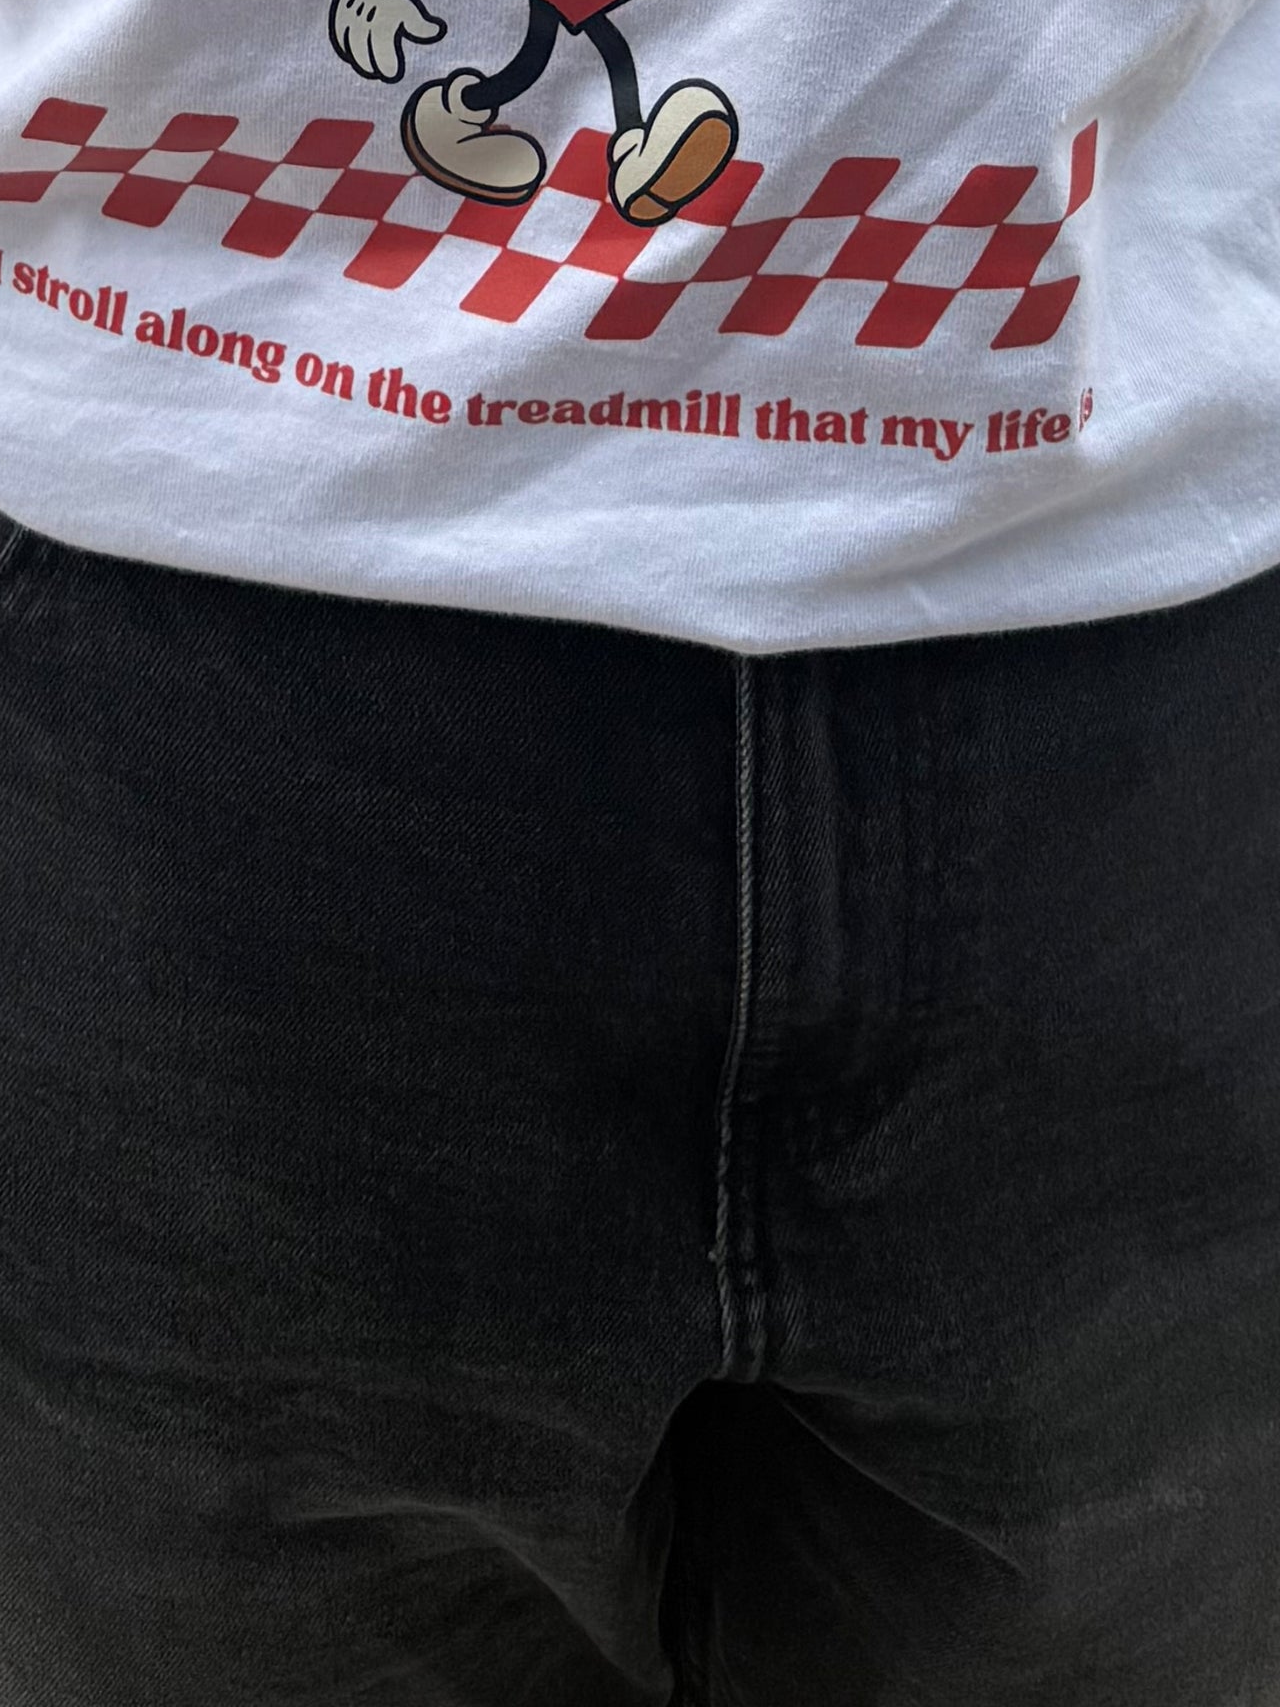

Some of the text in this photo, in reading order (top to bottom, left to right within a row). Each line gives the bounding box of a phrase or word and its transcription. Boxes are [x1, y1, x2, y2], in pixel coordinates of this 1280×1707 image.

[11, 260, 128, 336] stroll
[134, 307, 287, 385] along
[294, 351, 355, 402] on
[366, 366, 452, 426] the
[466, 389, 741, 439] treadmill
[754, 397, 867, 446] that
[881, 416, 974, 463] my
[986, 407, 1071, 454] life
